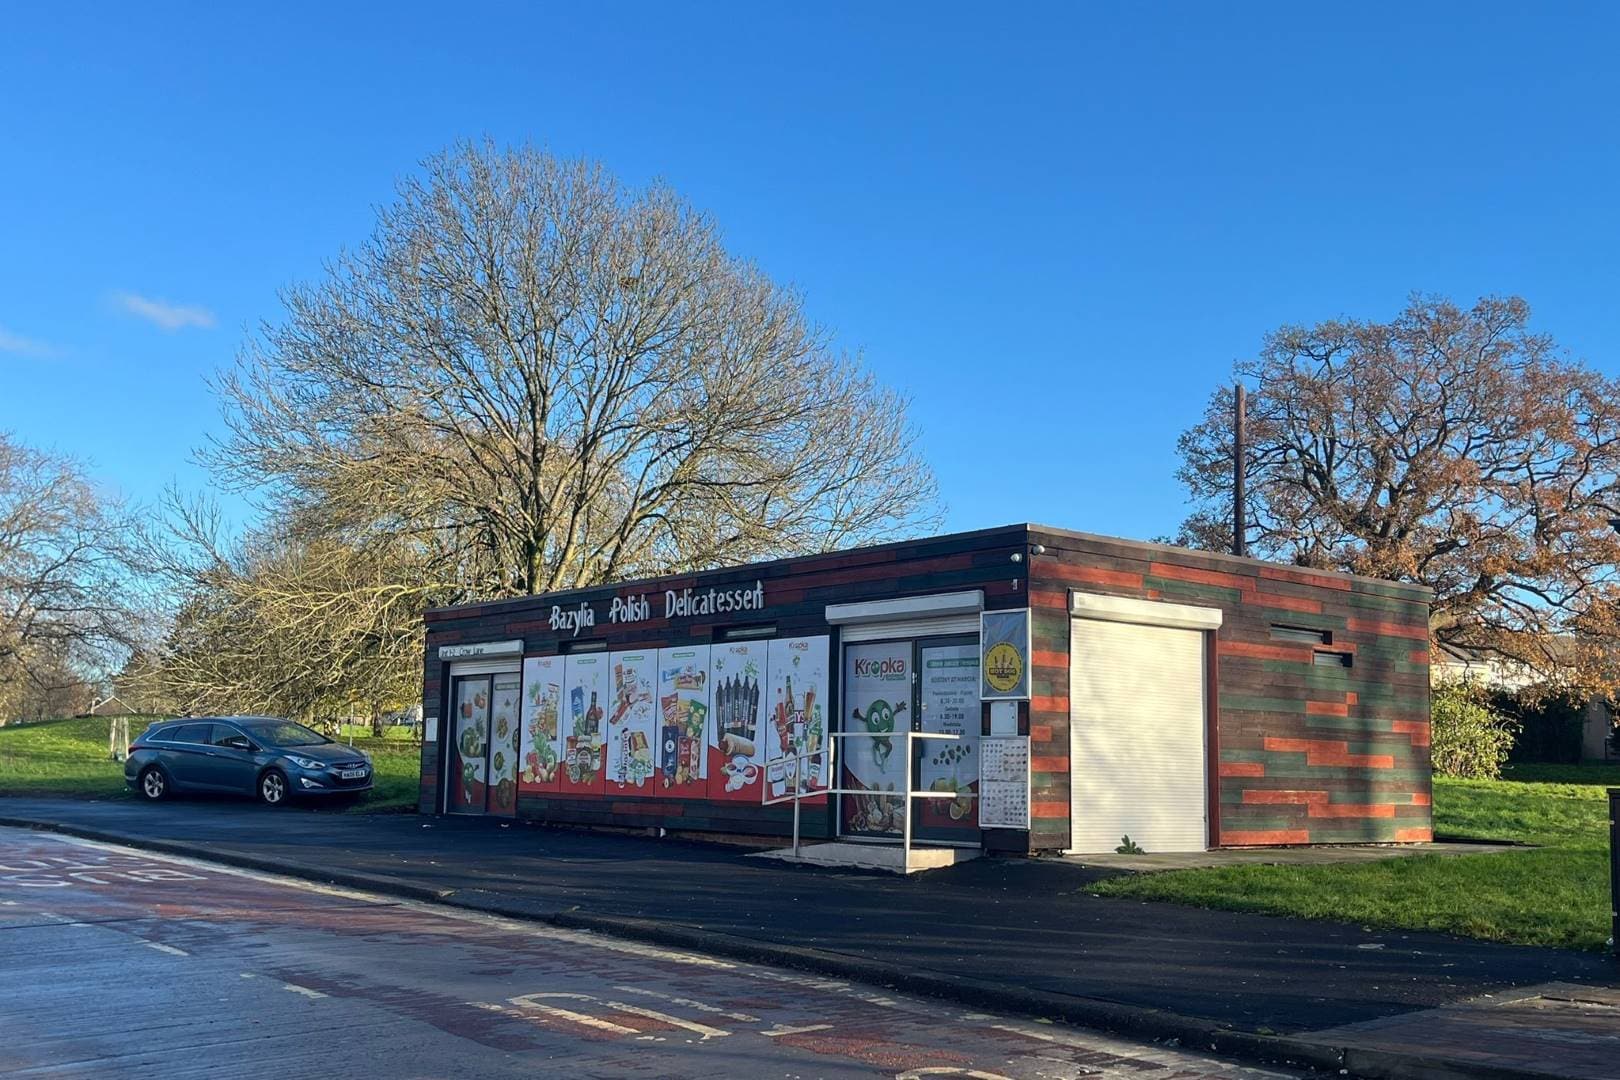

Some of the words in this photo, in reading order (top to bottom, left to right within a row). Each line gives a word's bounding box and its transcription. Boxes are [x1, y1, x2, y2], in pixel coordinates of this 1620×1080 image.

[548, 602, 595, 637] Bazylia
[609, 594, 650, 624] Polish
[665, 580, 764, 619] Delicatessen
[855, 657, 905, 679] Kropka
